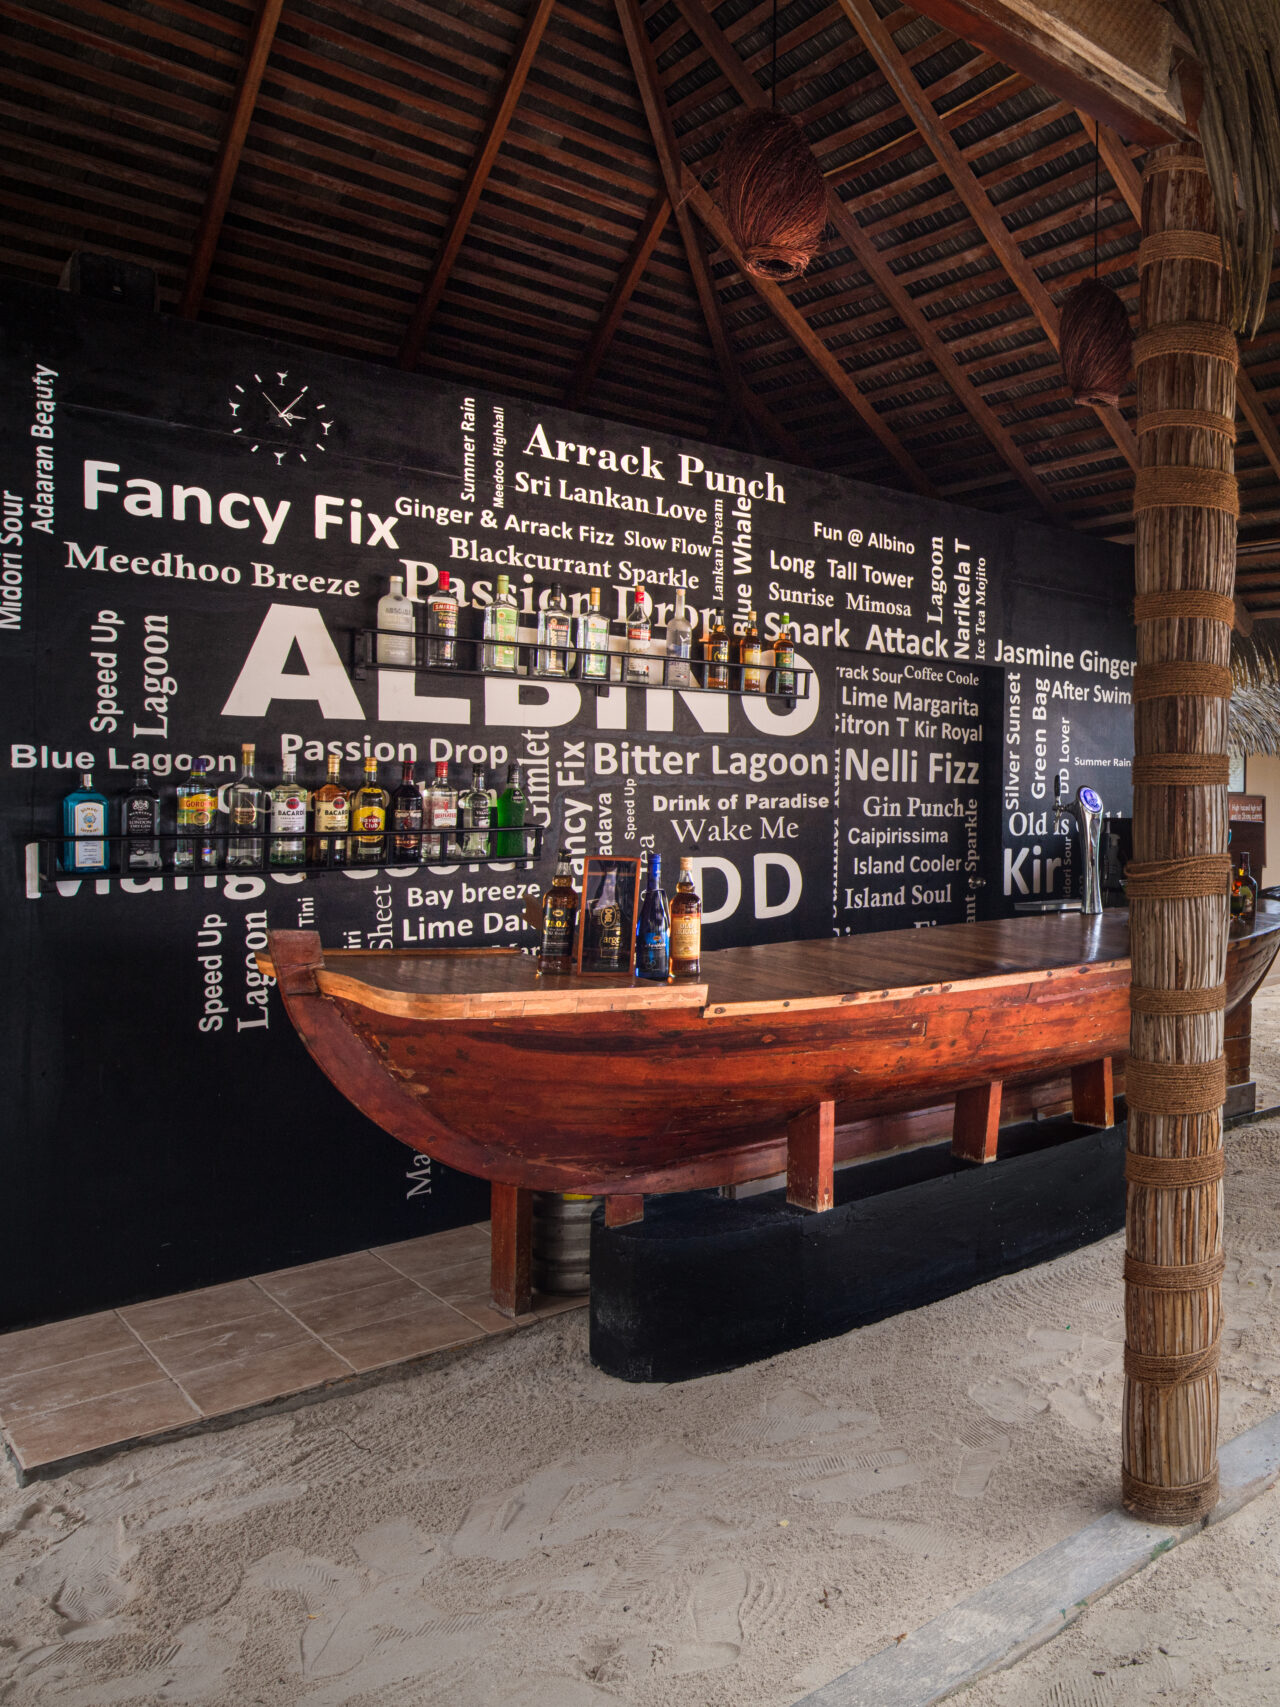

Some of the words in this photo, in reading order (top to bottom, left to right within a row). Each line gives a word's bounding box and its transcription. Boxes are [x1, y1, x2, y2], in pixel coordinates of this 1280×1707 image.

[31, 363, 59, 440] Beauty
[461, 397, 475, 432] Rain
[493, 406, 507, 457] Highball
[461, 435, 475, 502] Summer
[493, 460, 504, 508] Meedoo
[522, 423, 665, 481] Arrack
[677, 453, 787, 504] Punch
[30, 445, 55, 535] Adaaran
[84, 460, 291, 545] Fancy
[315, 495, 400, 550] Fix
[515, 471, 551, 498] Sri
[558, 479, 649, 515] Lankan
[656, 496, 708, 524] Love
[0, 490, 23, 546] Sour
[395, 496, 474, 527] Ginger
[480, 508, 498, 530] &
[504, 513, 573, 541] Arrack
[578, 525, 615, 546] Fizz
[713, 499, 724, 546] Dream
[732, 497, 752, 575] Whale
[813, 521, 843, 542] Fun
[847, 529, 864, 549] @
[868, 532, 916, 556] Albino
[449, 536, 611, 579] Blackcurrant
[618, 560, 700, 591] Sparkle
[624, 530, 666, 552] Slow
[671, 537, 713, 559] Flow
[954, 538, 971, 553] T
[63, 541, 242, 585] Meedhoo
[251, 562, 361, 597] Breeze
[713, 549, 724, 601] Lankan
[770, 549, 816, 580] Long
[827, 558, 857, 582] Tall
[862, 564, 914, 589] Tower
[926, 536, 948, 624] Lagoon
[975, 557, 988, 613] Mojito
[0, 552, 23, 630] Midori
[732, 584, 752, 637] Blue
[769, 582, 835, 608] Sunrise
[846, 592, 912, 618] Mimosa
[954, 562, 971, 660] Narikela
[90, 608, 126, 643] Up
[764, 612, 850, 648] Shark
[865, 624, 949, 659] Attack
[975, 616, 986, 641] Tea
[904, 665, 943, 682] Coffee
[975, 644, 986, 661] Ice
[994, 639, 1074, 669] Jasmine
[1079, 649, 1137, 679] Ginger
[90, 652, 124, 734] Speed
[132, 614, 178, 739] Lagoon
[872, 670, 903, 684] Sour
[1051, 680, 1090, 701] After
[1093, 685, 1131, 704] Swim
[842, 686, 888, 709] Lime
[894, 691, 978, 717] Margarita
[1006, 673, 1021, 745] Sunset
[1032, 678, 1050, 720] Bag
[835, 713, 889, 736] itron
[896, 717, 909, 738] T
[914, 720, 937, 739] Kir
[941, 722, 983, 744] Royal
[1059, 717, 1070, 762] Lover
[10, 744, 95, 769] Blue
[109, 747, 237, 777] Lagoon
[281, 733, 417, 763] Passion
[429, 738, 509, 770] Drop
[556, 741, 586, 786] Fix
[594, 741, 700, 775] Bitter
[712, 745, 829, 783] Lagoon
[844, 748, 918, 783] Nelli
[929, 752, 980, 785] Fizz
[1031, 728, 1047, 799] Green
[1074, 757, 1110, 767] Summer
[1113, 758, 1131, 768] Rain
[516, 730, 551, 828] Gimlet
[624, 778, 639, 796] Up
[1005, 752, 1020, 811] Silver
[624, 799, 638, 841] Speed
[653, 796, 710, 812] Drink
[718, 794, 738, 811] of
[746, 794, 830, 810] Paradise
[863, 796, 901, 817] Gin
[907, 797, 965, 817] Punch
[1008, 811, 1047, 836] Old
[670, 816, 753, 843] Wake
[759, 816, 800, 840] Me
[848, 827, 949, 848] Caipirissima
[965, 799, 980, 872] Sparkle
[1063, 836, 1072, 865] Sour
[853, 856, 905, 875] Island
[909, 854, 962, 873] Cooler
[1003, 845, 1062, 896] Kir
[1063, 867, 1072, 898] idori
[298, 897, 314, 928] Tini
[407, 887, 454, 910] Bay
[461, 882, 541, 904] breeze
[844, 885, 906, 910] Island
[911, 884, 952, 906] Soul
[198, 913, 227, 946] Up
[403, 917, 474, 942] Lime
[198, 953, 228, 1032] Speed
